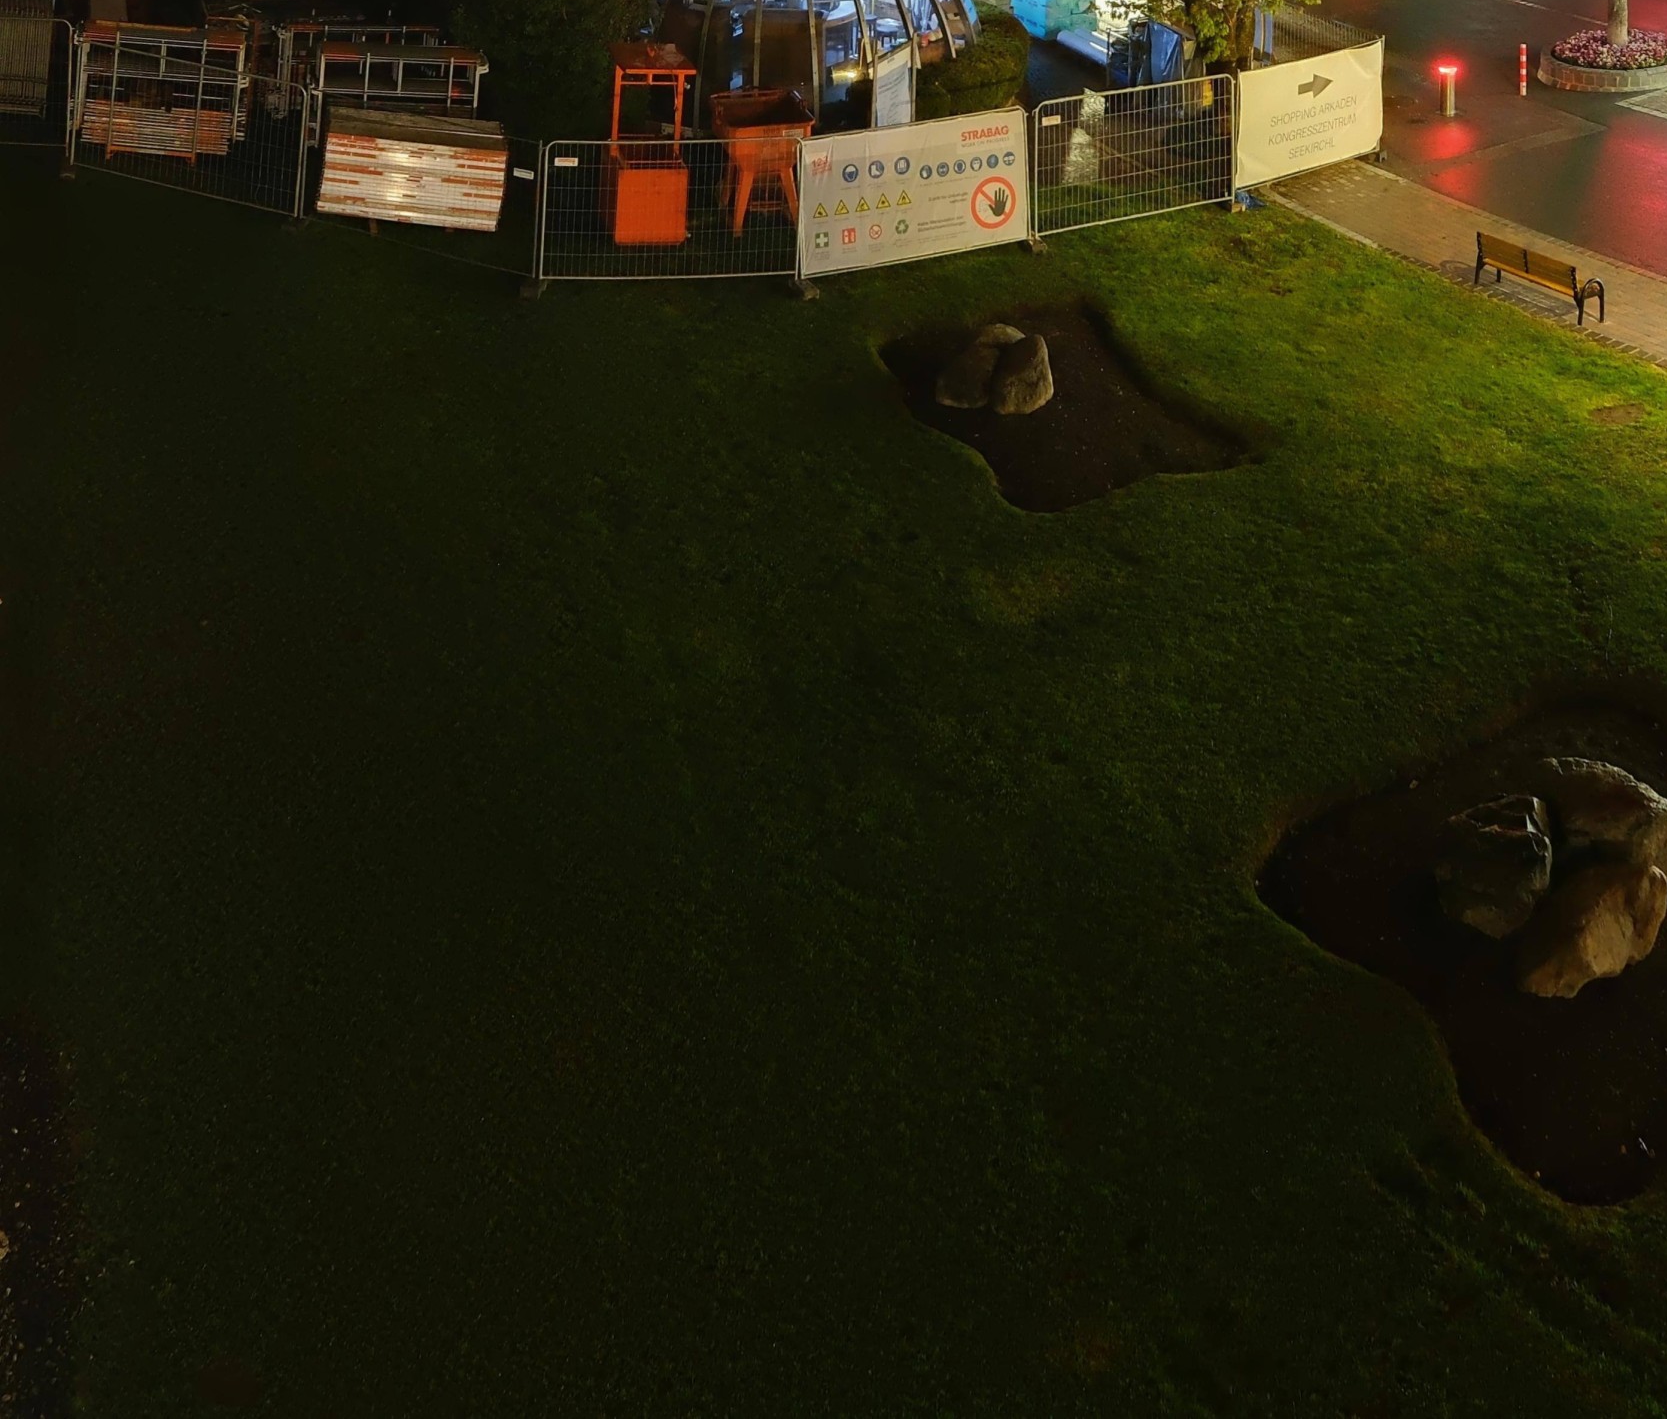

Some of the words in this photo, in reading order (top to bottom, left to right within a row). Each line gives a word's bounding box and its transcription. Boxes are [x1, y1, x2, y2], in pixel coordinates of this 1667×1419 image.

[1270, 106, 1317, 128] SHOPPING
[1318, 95, 1358, 116] ARKADEN
[961, 125, 1009, 142] STRABAG
[1268, 112, 1357, 146] KONGRESSZENTRUM
